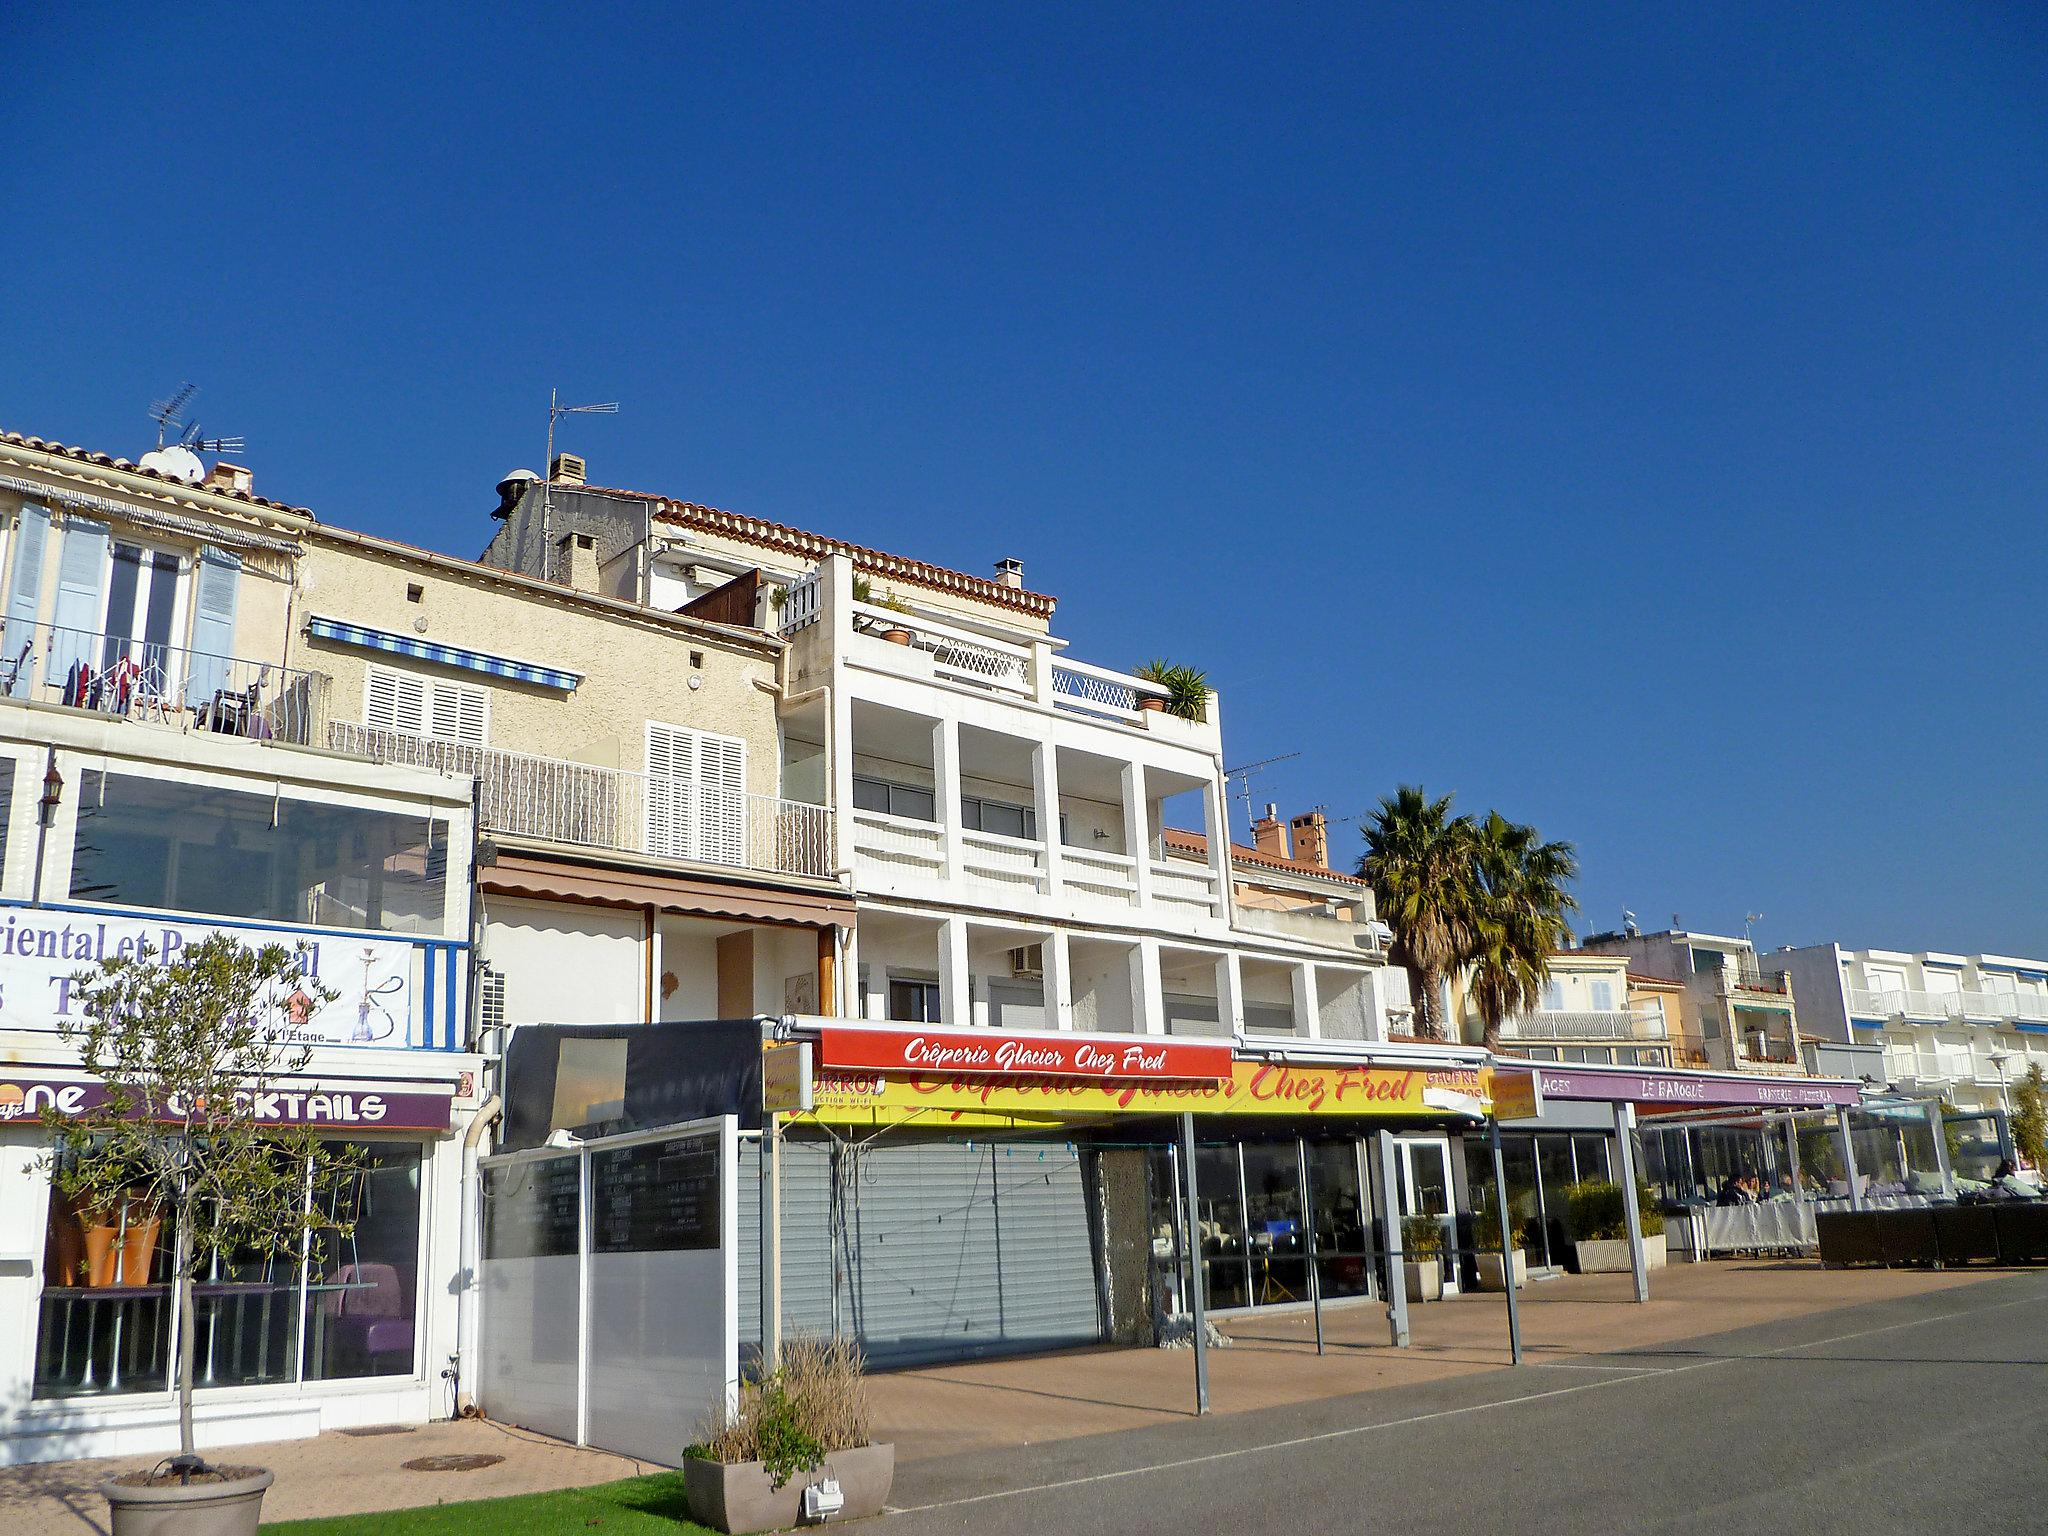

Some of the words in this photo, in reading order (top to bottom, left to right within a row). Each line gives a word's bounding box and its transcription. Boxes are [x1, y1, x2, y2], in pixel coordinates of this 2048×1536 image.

[0, 915, 105, 962] iental
[117, 929, 149, 965] et
[903, 1037, 991, 1069] Crêperie
[994, 1041, 1065, 1071] Glacier
[1074, 1044, 1117, 1075] Chez
[1122, 1045, 1168, 1071] Fred
[813, 1071, 880, 1095] URROS
[1250, 1064, 1326, 1111] Chez
[1335, 1066, 1414, 1101] Fred
[1541, 1077, 1571, 1093] ACES
[1658, 1080, 1705, 1098] BAROQUE
[1757, 1086, 1793, 1101] BRASSERIE
[167, 1090, 388, 1121] CCKTAILS
[814, 1096, 844, 1104] ECTION
